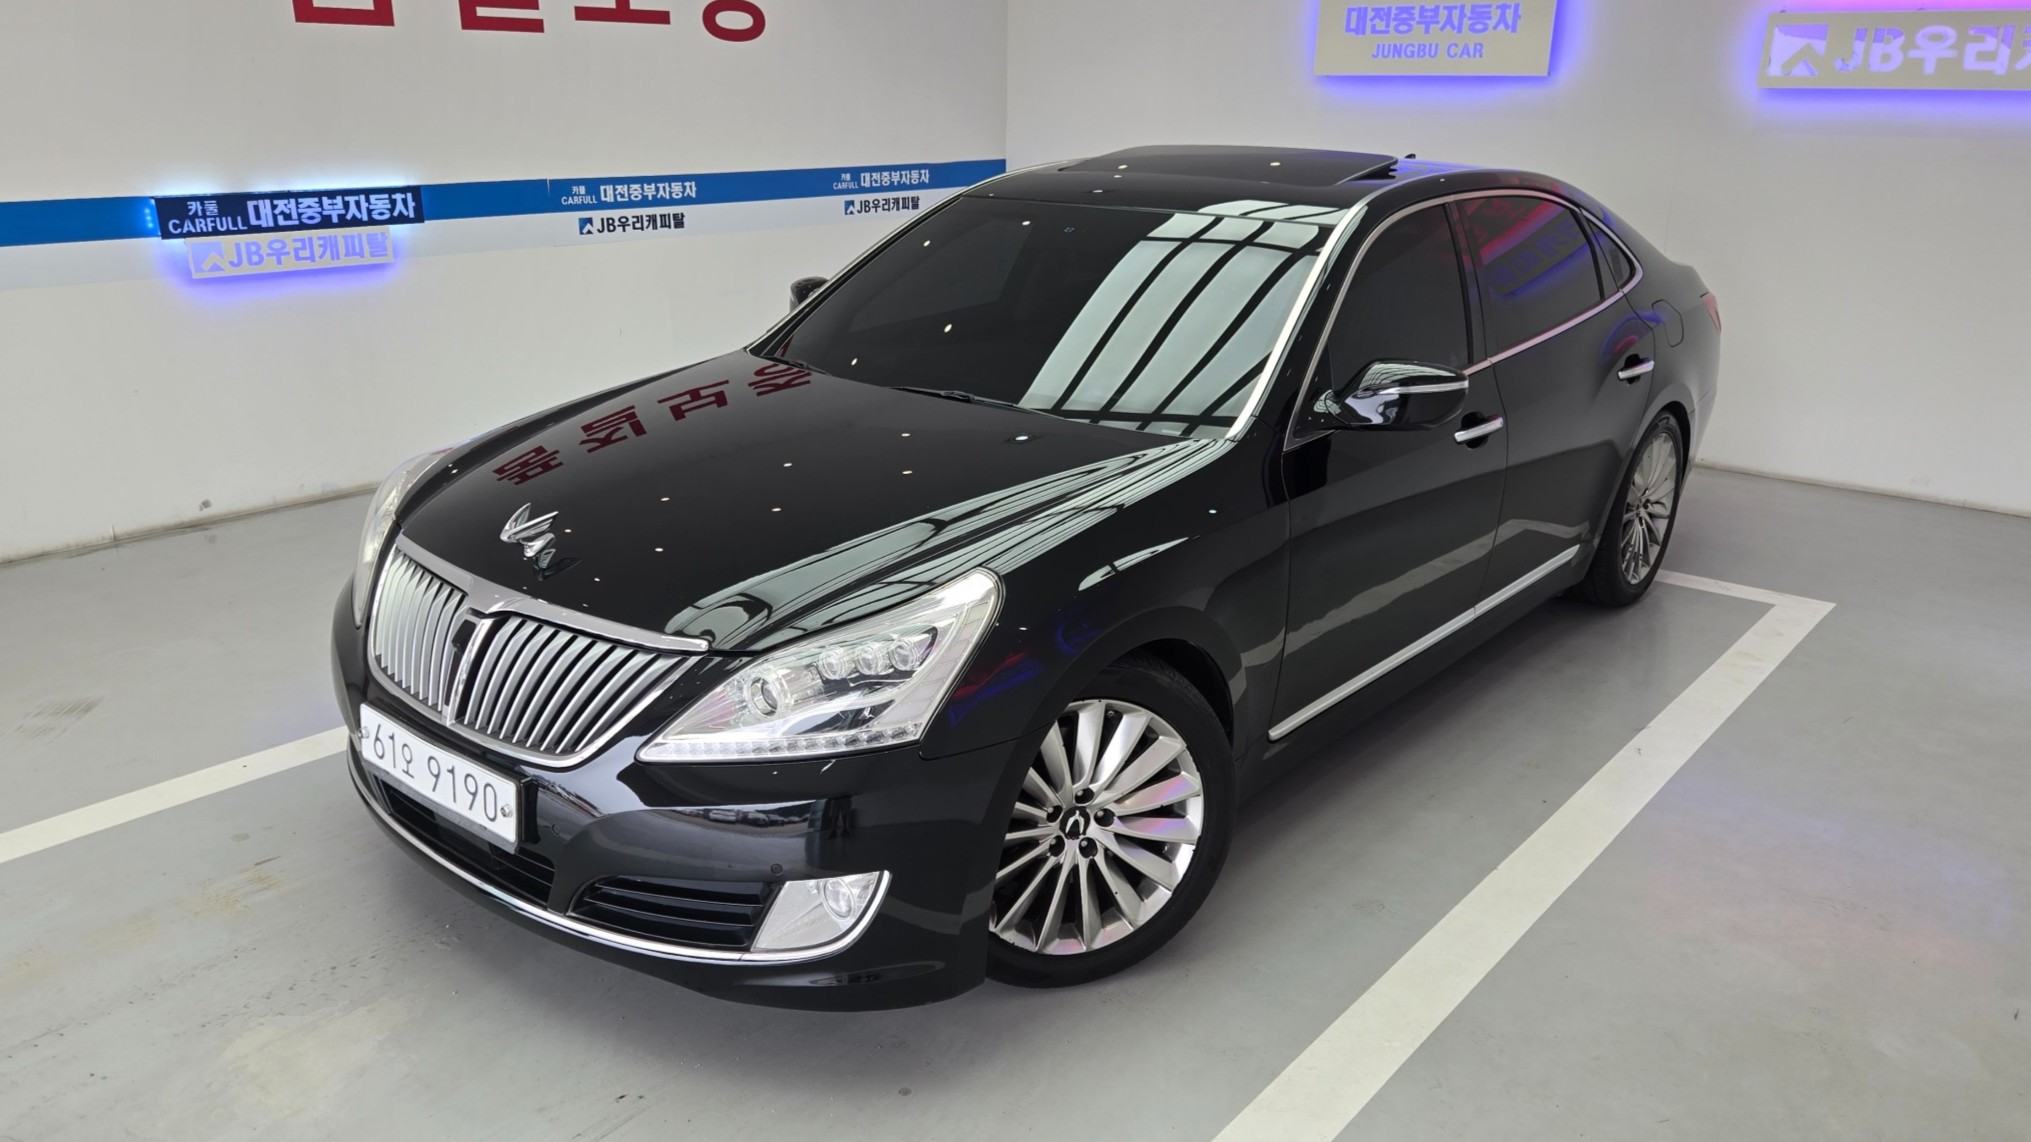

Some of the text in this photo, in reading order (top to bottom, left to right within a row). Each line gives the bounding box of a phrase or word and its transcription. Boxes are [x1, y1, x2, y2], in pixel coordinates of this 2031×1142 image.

[1344, 3, 1522, 36] 대전중부자동차
[1371, 42, 1485, 59] JUNGBU CAR
[860, 169, 929, 187] 대전중부자동차
[561, 195, 598, 205] CARFULL
[600, 181, 697, 203] 대전중부자동차
[247, 193, 416, 228] 대전중부자동차
[857, 196, 920, 214] JB우리캐피탈
[168, 216, 248, 234] CARFULL
[596, 212, 685, 234] JB우리캐피탈
[228, 231, 390, 269] JB우리캐피탈
[373, 724, 498, 822] 61오 9190
